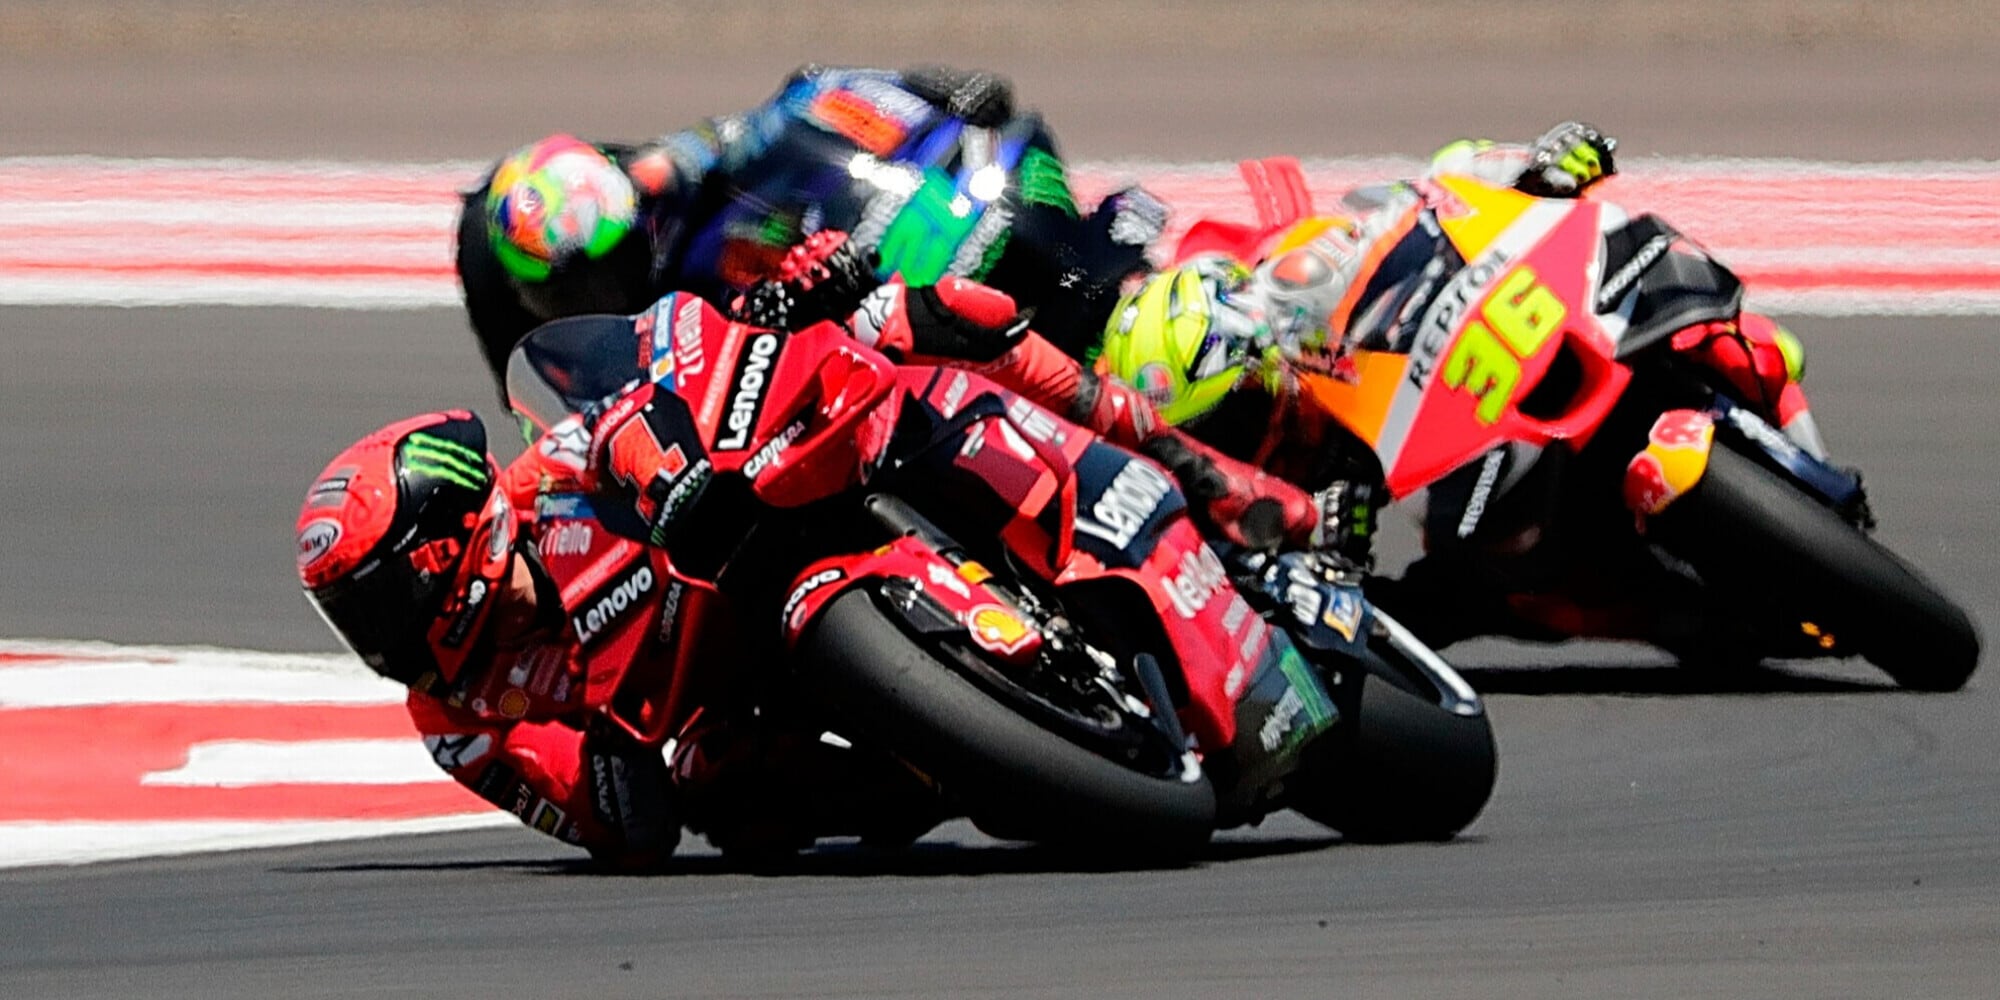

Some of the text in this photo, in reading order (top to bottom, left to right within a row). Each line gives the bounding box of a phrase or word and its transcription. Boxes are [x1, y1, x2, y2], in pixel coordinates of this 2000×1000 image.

[717, 333, 778, 450] Lenovo
[1442, 266, 1567, 425] 36
[743, 421, 806, 479] CARRERA
[573, 566, 653, 644] Lenovo
